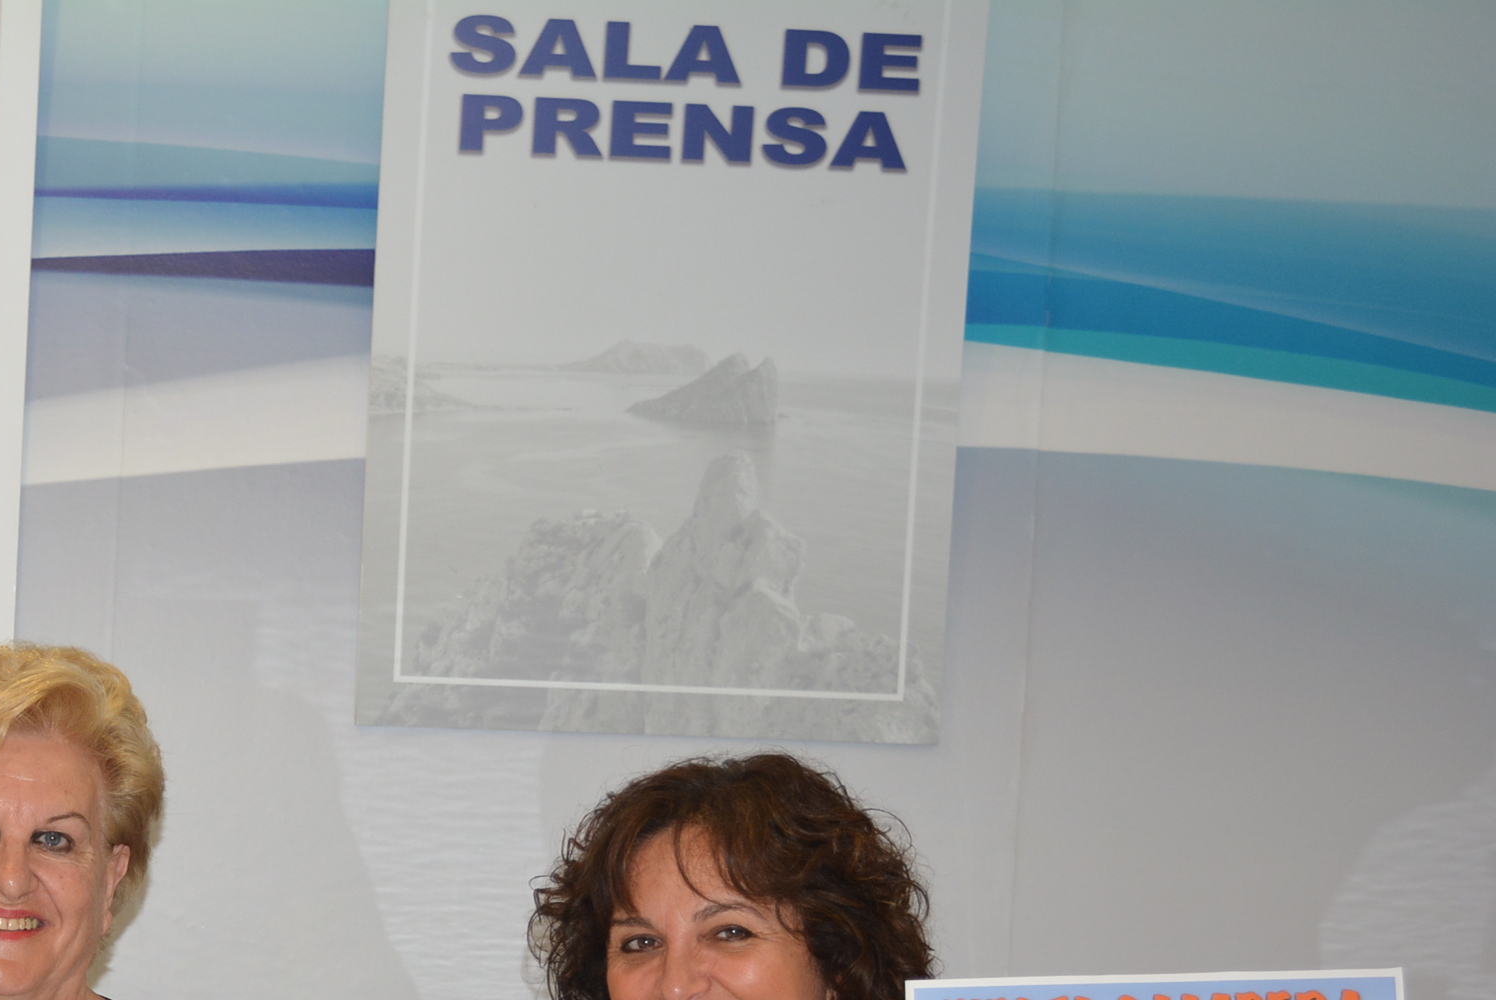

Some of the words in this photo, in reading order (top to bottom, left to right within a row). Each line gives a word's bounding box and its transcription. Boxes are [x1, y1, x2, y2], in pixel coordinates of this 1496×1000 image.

[450, 15, 741, 86] SALA
[781, 28, 923, 95] DE
[457, 94, 907, 173] PRENSA
